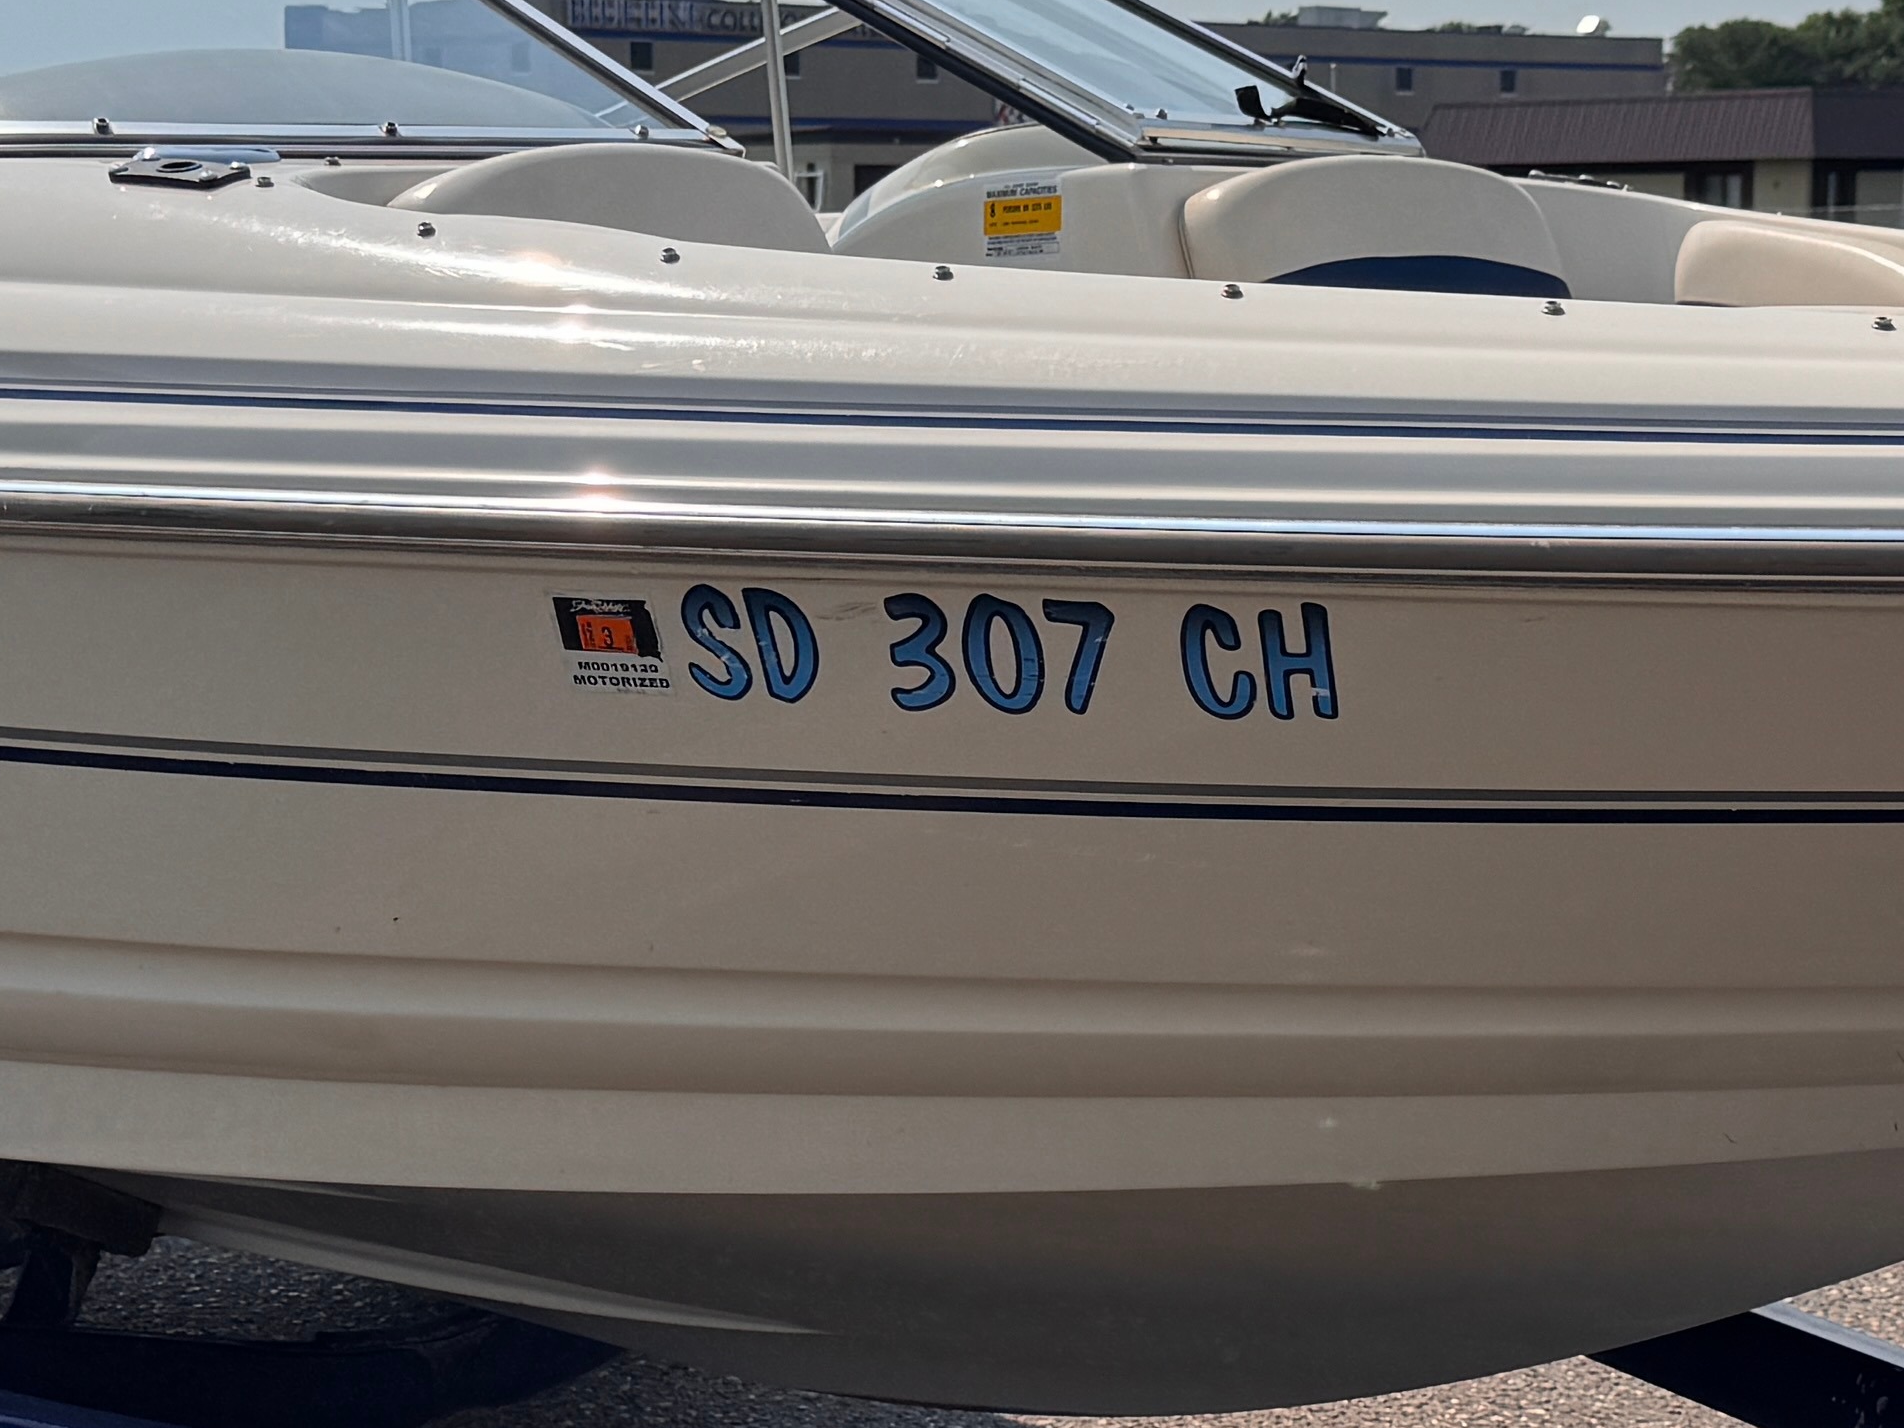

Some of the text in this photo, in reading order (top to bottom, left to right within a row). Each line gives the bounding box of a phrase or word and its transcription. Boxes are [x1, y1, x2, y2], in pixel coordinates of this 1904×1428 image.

[1020, 185, 1058, 196] CAPACITIES
[680, 583, 1339, 720] SD 307 CH
[573, 674, 670, 689] MOTORIZED
